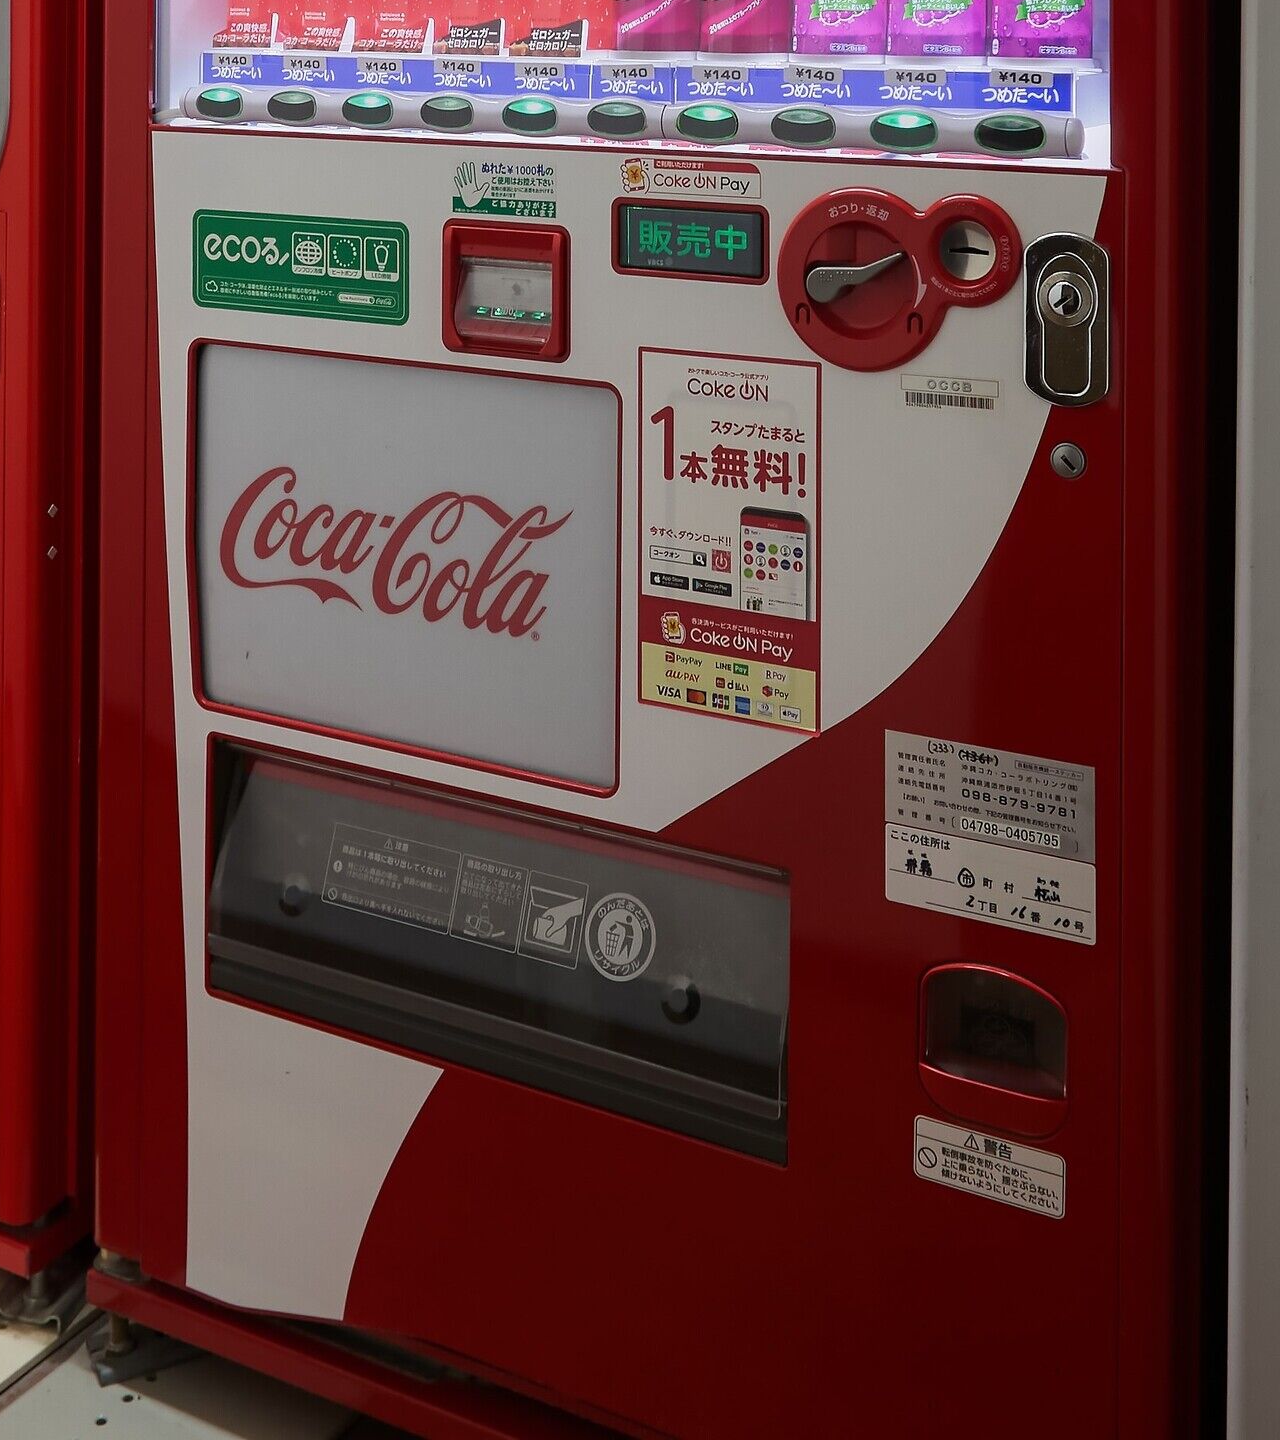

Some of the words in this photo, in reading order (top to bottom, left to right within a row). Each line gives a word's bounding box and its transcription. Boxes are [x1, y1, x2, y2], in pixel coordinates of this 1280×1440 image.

[450, 27, 498, 38] ゼロシュガー
[531, 30, 579, 40] ゼロシュガー
[796, 68, 835, 81] ¥140
[896, 72, 937, 84] ¥140
[999, 71, 1042, 85] ¥140
[491, 177, 554, 186] ご使用はお控え下さい
[653, 172, 690, 189] Coke
[694, 173, 716, 190] ON
[720, 177, 750, 195] Pay
[828, 202, 890, 221] おつり・返却
[638, 220, 747, 260] 販売中
[688, 368, 769, 380] おトクで楽しいコカ・コーラ公式アプリ
[688, 378, 735, 398] Coke
[739, 380, 768, 402] ON
[711, 420, 805, 443] スタンプたまると
[651, 406, 806, 498] 1本無料!
[650, 526, 732, 546] 今すぐ、ダウンロード!!
[654, 549, 680, 559] コークオン
[691, 618, 793, 640] 各決済サービスがご利用いただけます!
[690, 627, 730, 647] Coke
[733, 633, 757, 653] ON
[761, 641, 793, 662] Pay
[676, 654, 702, 666] PayPay
[715, 661, 732, 671] LINE
[735, 665, 748, 674] Pay
[665, 669, 683, 679] au
[684, 672, 699, 682] PAY
[656, 685, 681, 699] VISA
[928, 740, 954, 754] (233)
[898, 751, 946, 767] 管理責任者氏名
[961, 788, 1076, 820] 098-879-9781
[890, 830, 951, 851] ここの住所は
[961, 818, 1059, 848] 04798-0405795
[984, 1138, 1013, 1160] 警告
[941, 1146, 1032, 1181] 転倒事故を防ぐために、
[941, 1159, 1059, 1199] 上に乗らない、揺さぶらない、
[941, 1169, 1060, 1211] 傾けないようにしてください。
